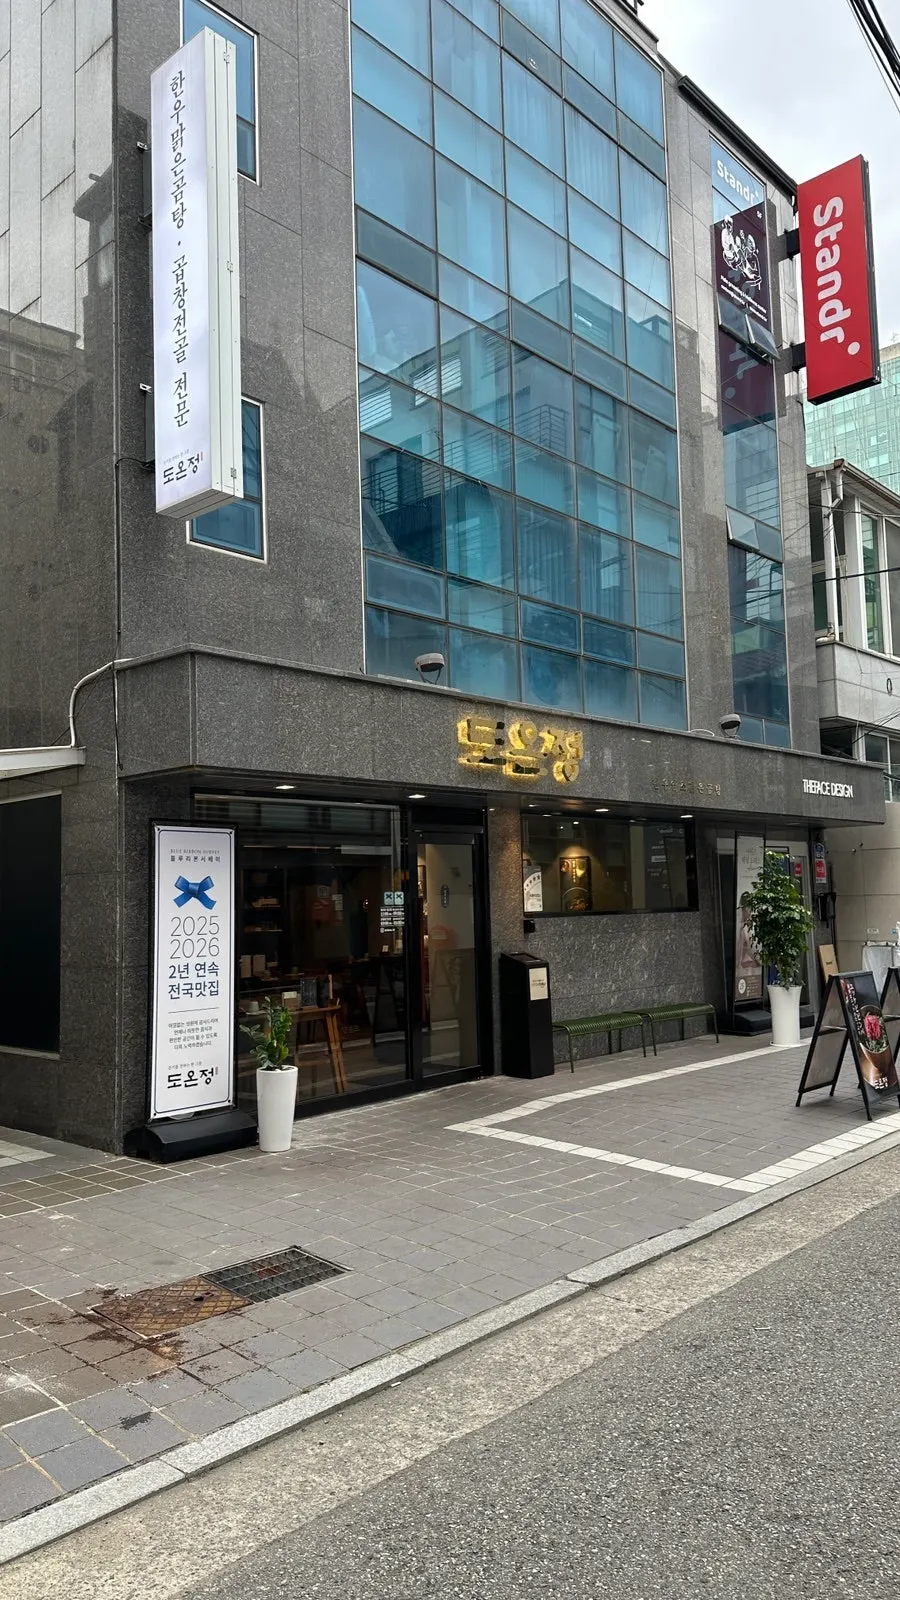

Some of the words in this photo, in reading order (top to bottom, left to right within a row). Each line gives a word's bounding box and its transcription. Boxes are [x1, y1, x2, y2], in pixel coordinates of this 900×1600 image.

[170, 70, 187, 229] 한우맑은곰탕
[172, 254, 188, 364] 곱창전골
[174, 372, 190, 428] 전문
[163, 453, 200, 485] 도온정
[457, 717, 584, 784] 도온정
[830, 782, 854, 798] DESIGN
[170, 915, 220, 937] 2025
[170, 937, 220, 960] 2026
[168, 962, 190, 979] 2년
[194, 961, 220, 978] 연속
[168, 979, 220, 1000] 전국맛집
[167, 1067, 214, 1089] 도온정
